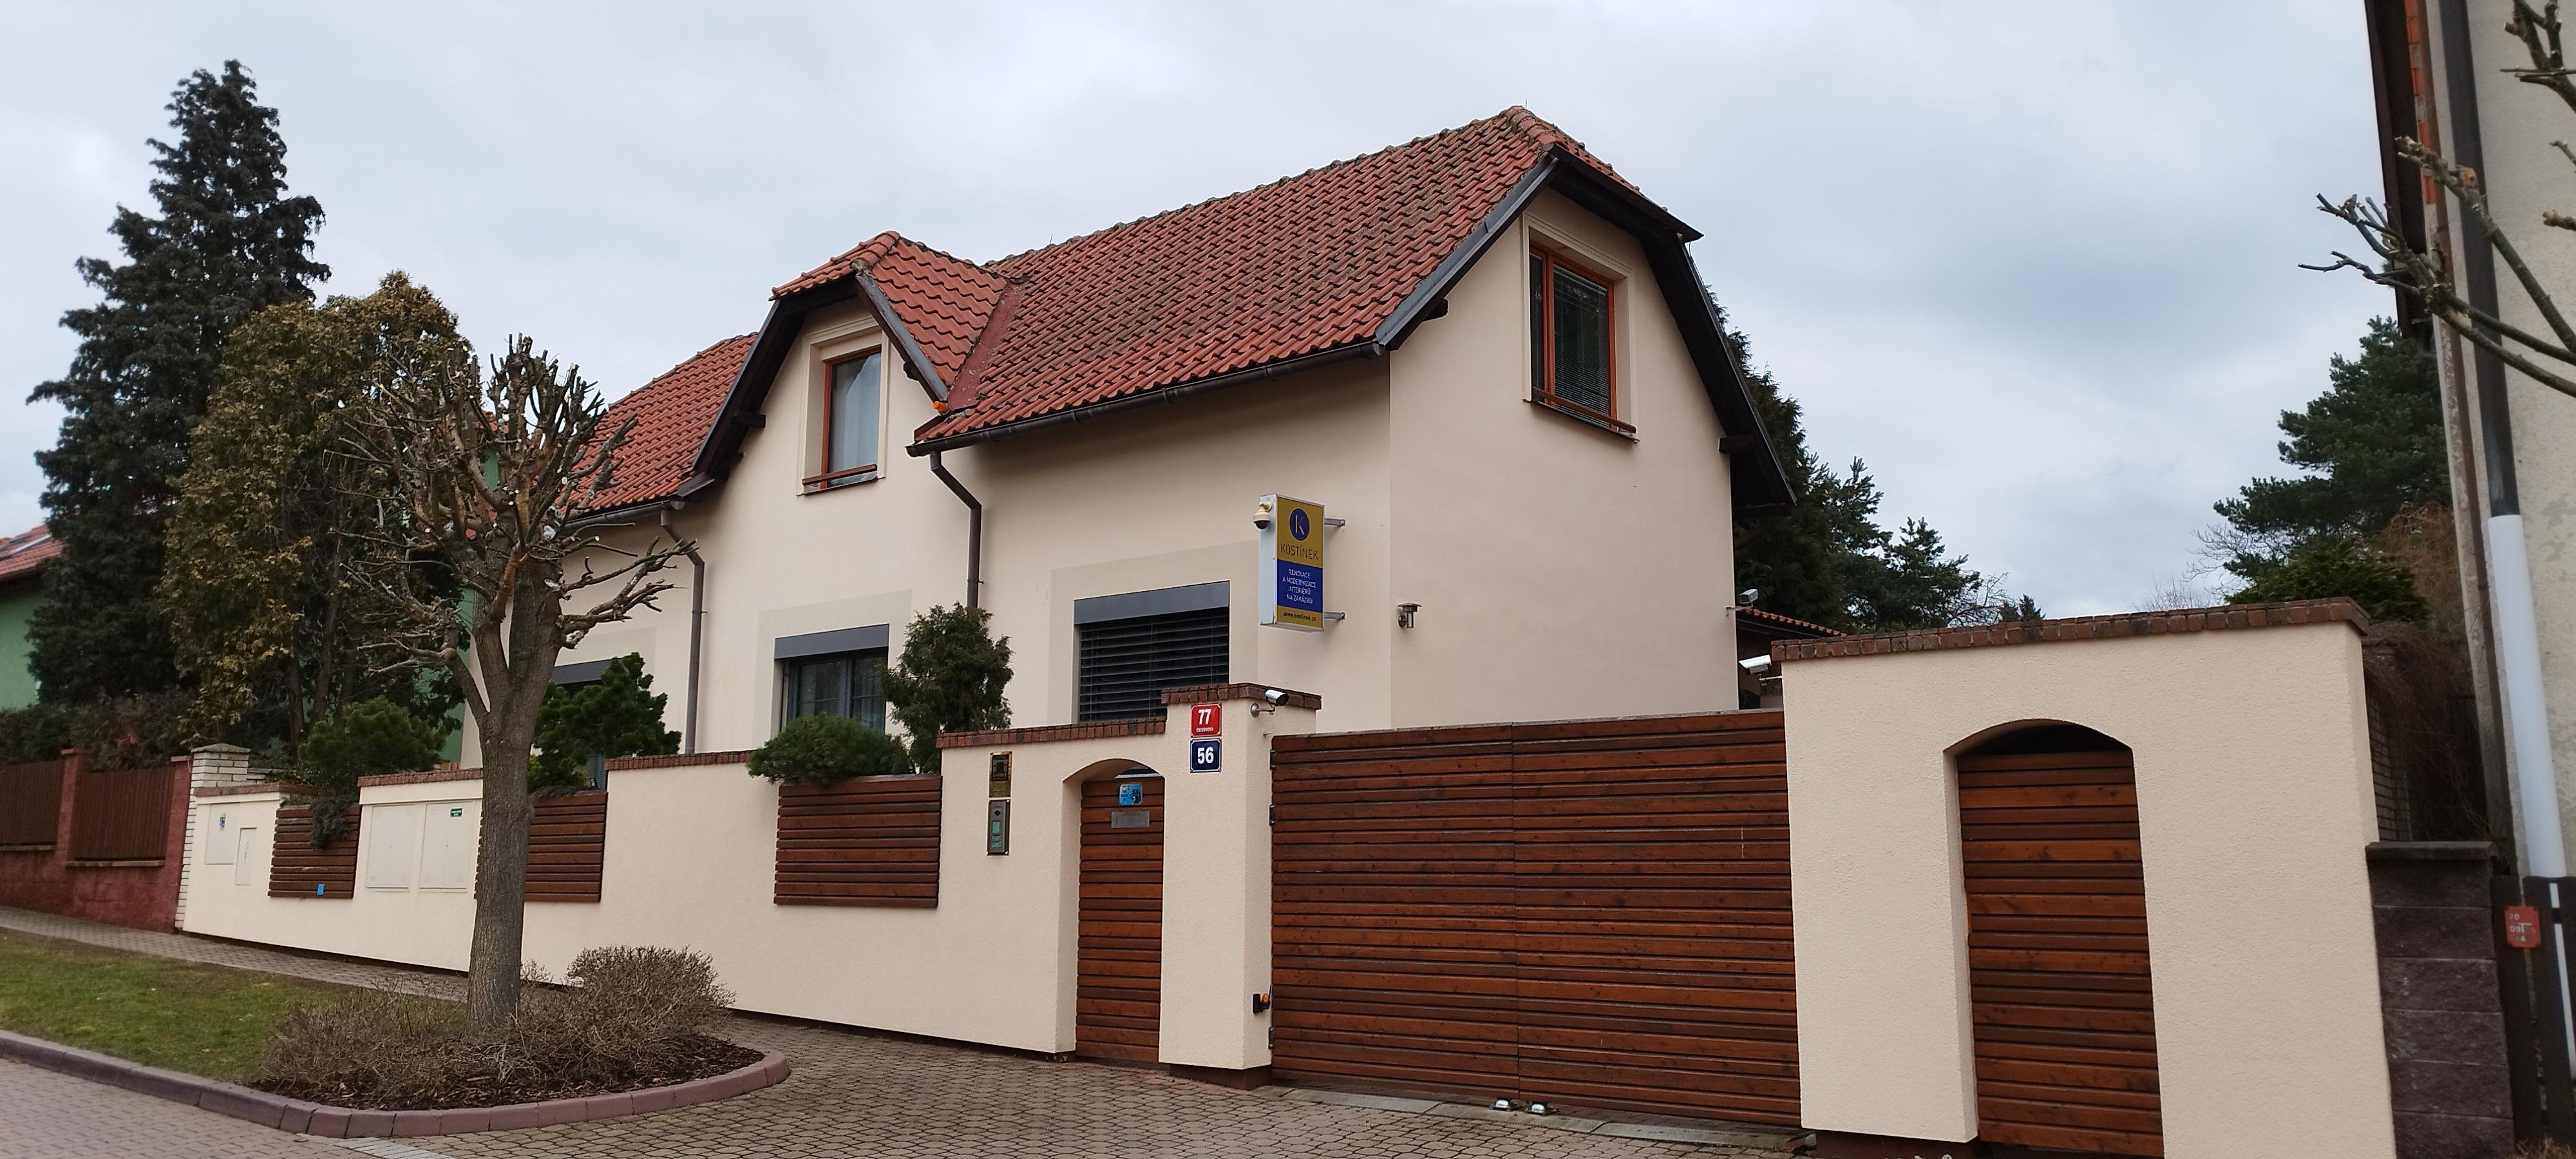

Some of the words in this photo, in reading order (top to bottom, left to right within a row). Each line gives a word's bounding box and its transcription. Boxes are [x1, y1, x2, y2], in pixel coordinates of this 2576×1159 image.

[1288, 569, 1311, 579] RENOVACE
[1286, 577, 1317, 588] MODERNIZACE
[1293, 594, 1313, 604] ZAKÁZKU
[1198, 708, 1211, 725] 77
[1197, 746, 1214, 764] 56
